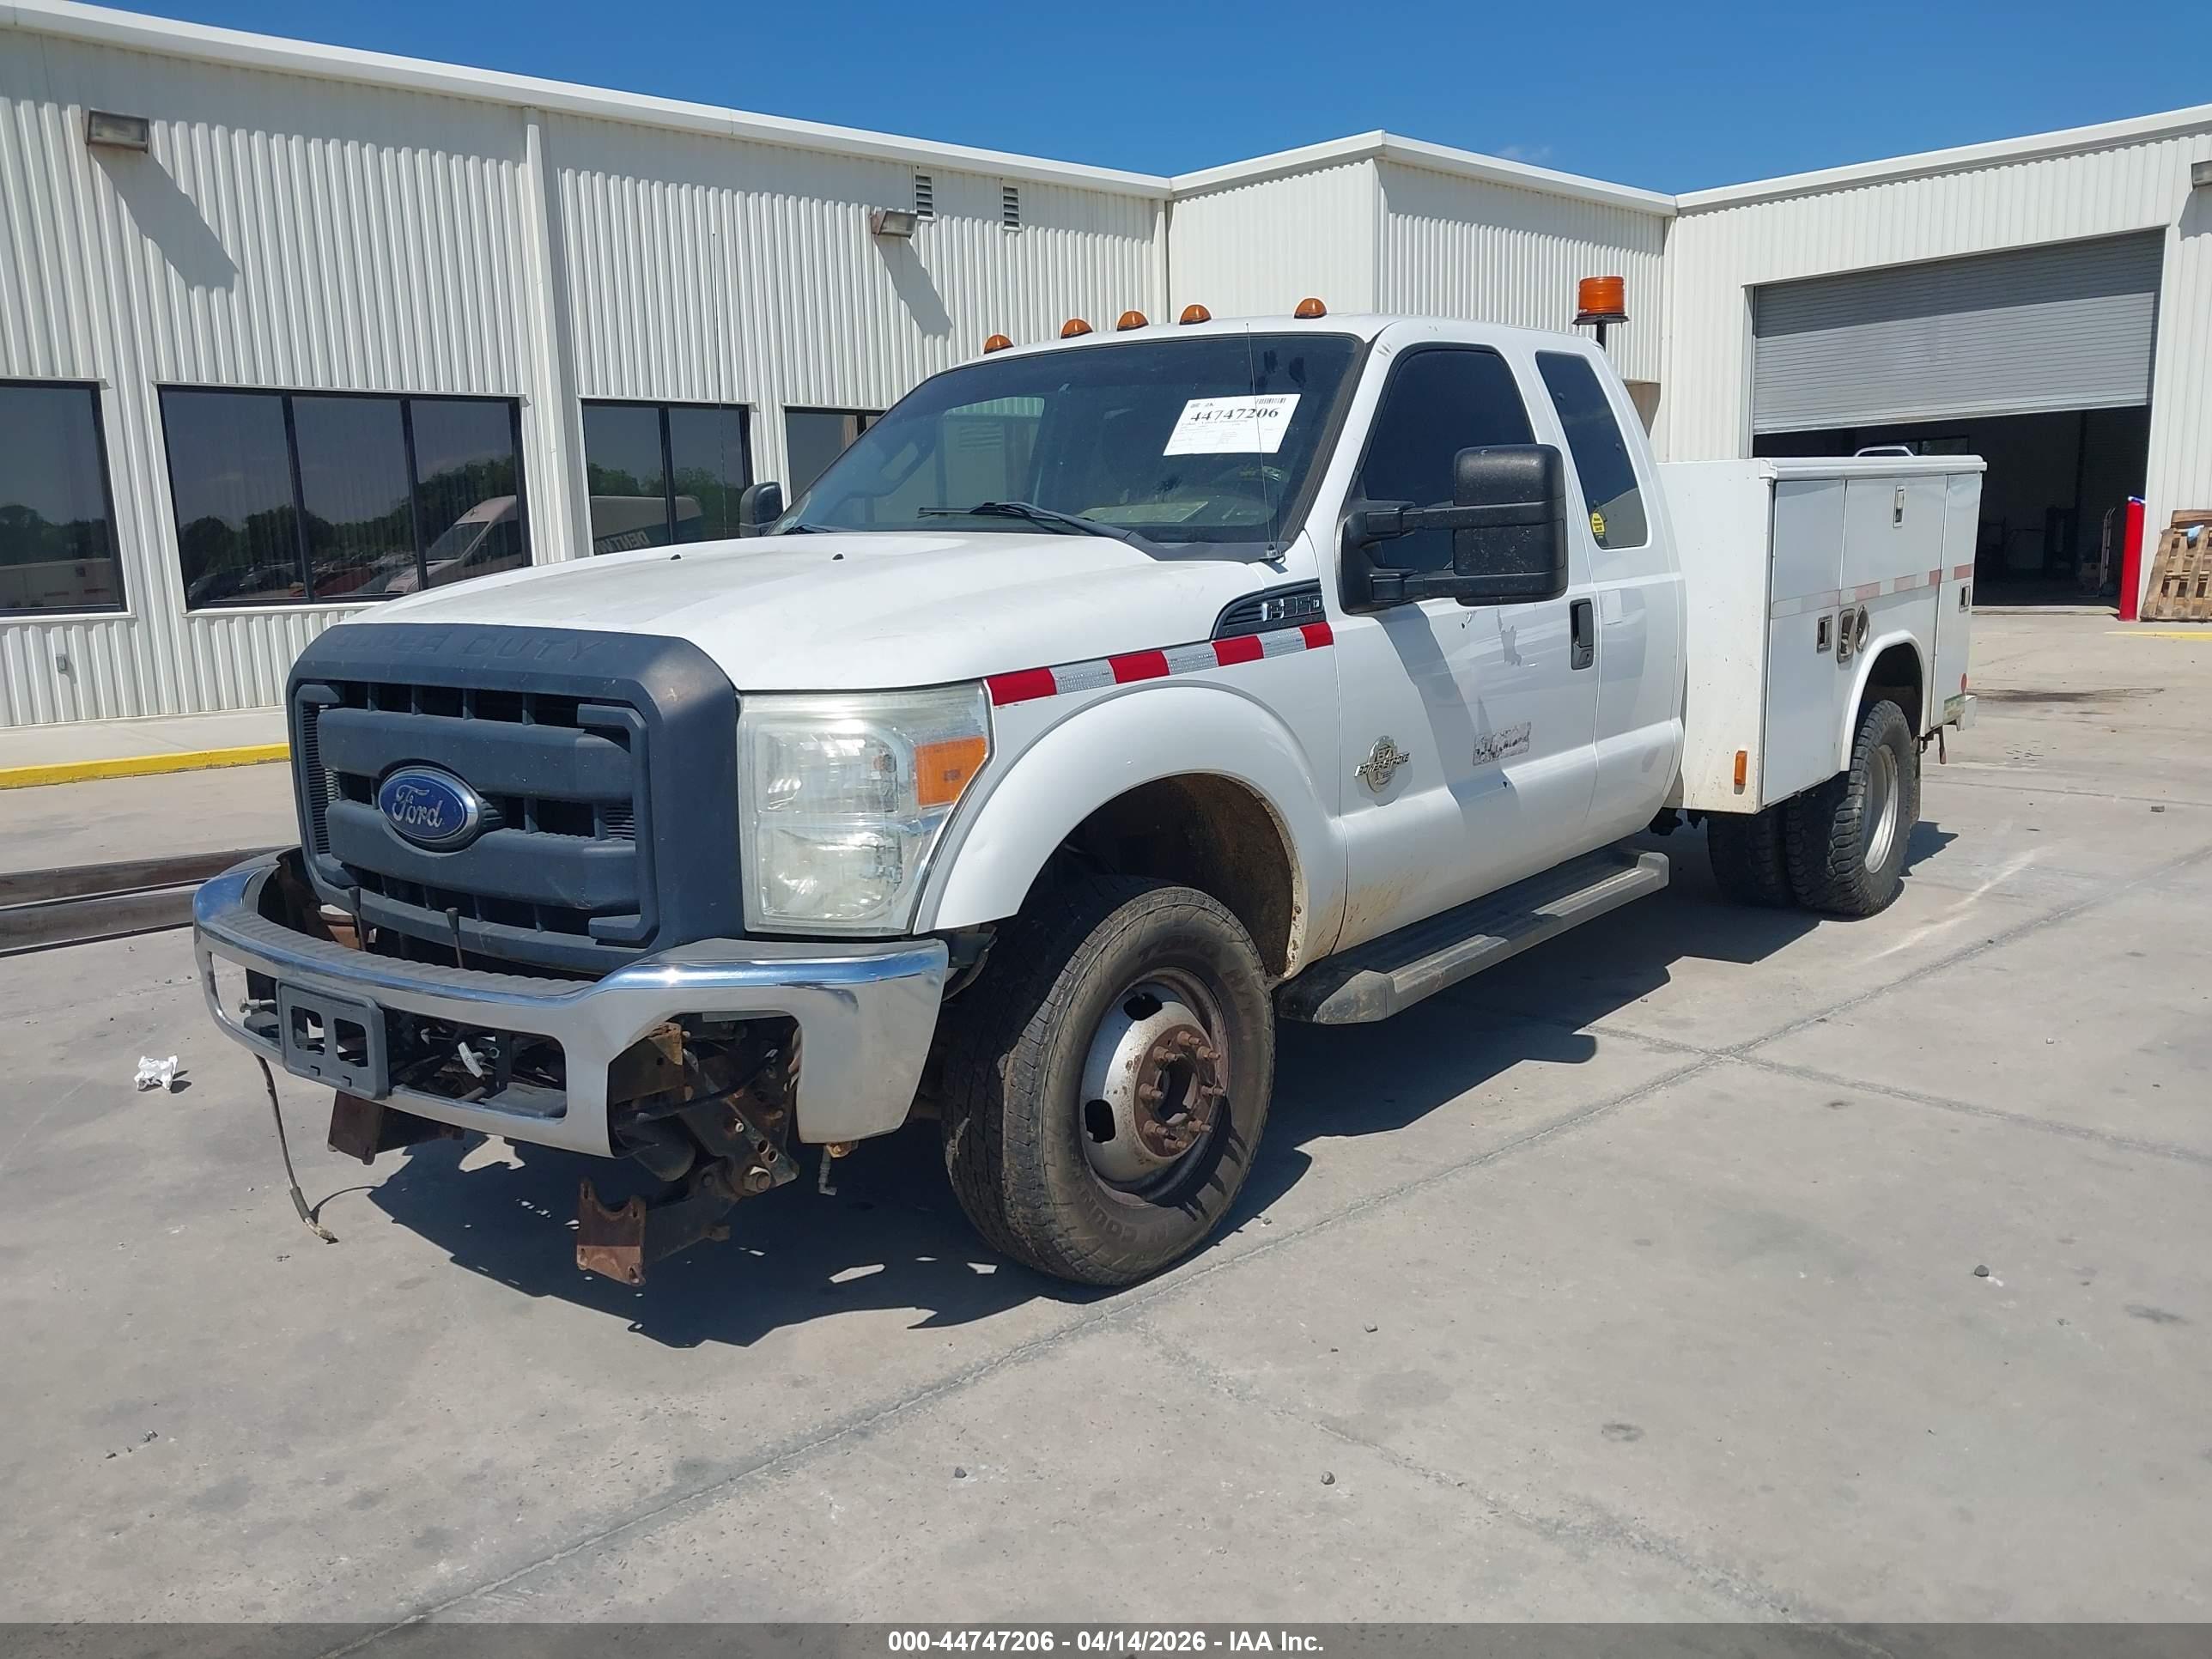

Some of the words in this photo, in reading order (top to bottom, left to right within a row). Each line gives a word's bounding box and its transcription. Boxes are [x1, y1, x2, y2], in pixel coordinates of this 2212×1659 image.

[1190, 407, 1279, 422] 44747206
[459, 632, 604, 662] DUTY
[392, 784, 443, 828] Ford
